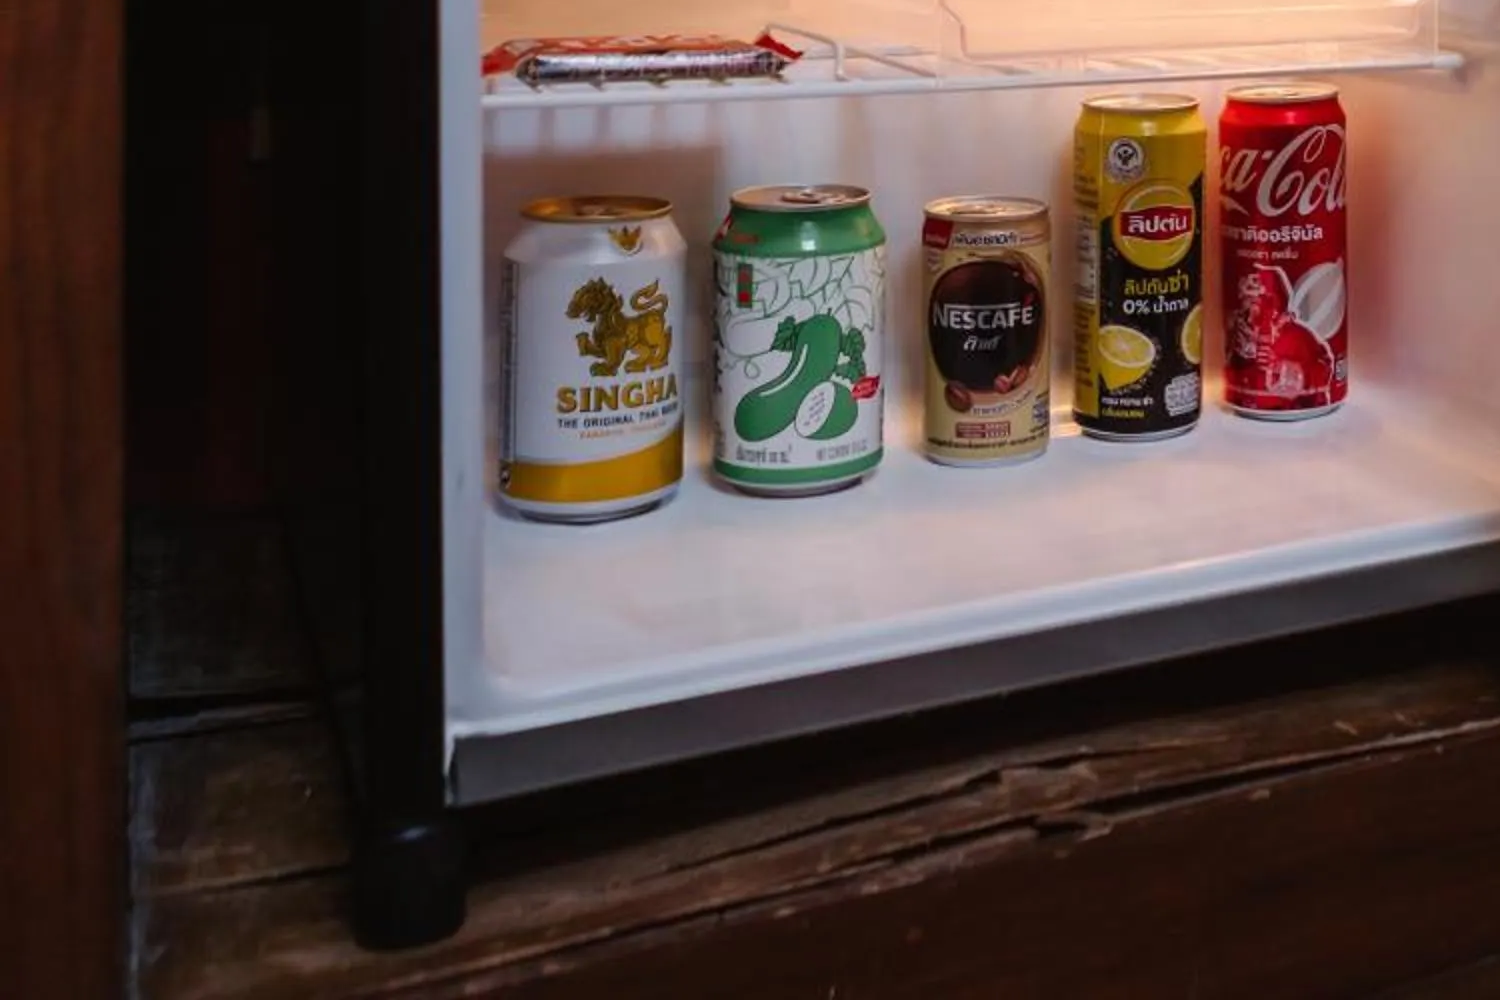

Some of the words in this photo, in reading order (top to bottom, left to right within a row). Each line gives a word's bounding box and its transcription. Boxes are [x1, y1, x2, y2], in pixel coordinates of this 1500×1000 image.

[1127, 213, 1189, 234] ลิปตัน
[1122, 299, 1152, 315] 0%
[556, 372, 679, 414] SINGHA
[557, 418, 579, 429] THE
[583, 414, 634, 428] ORIGINAL
